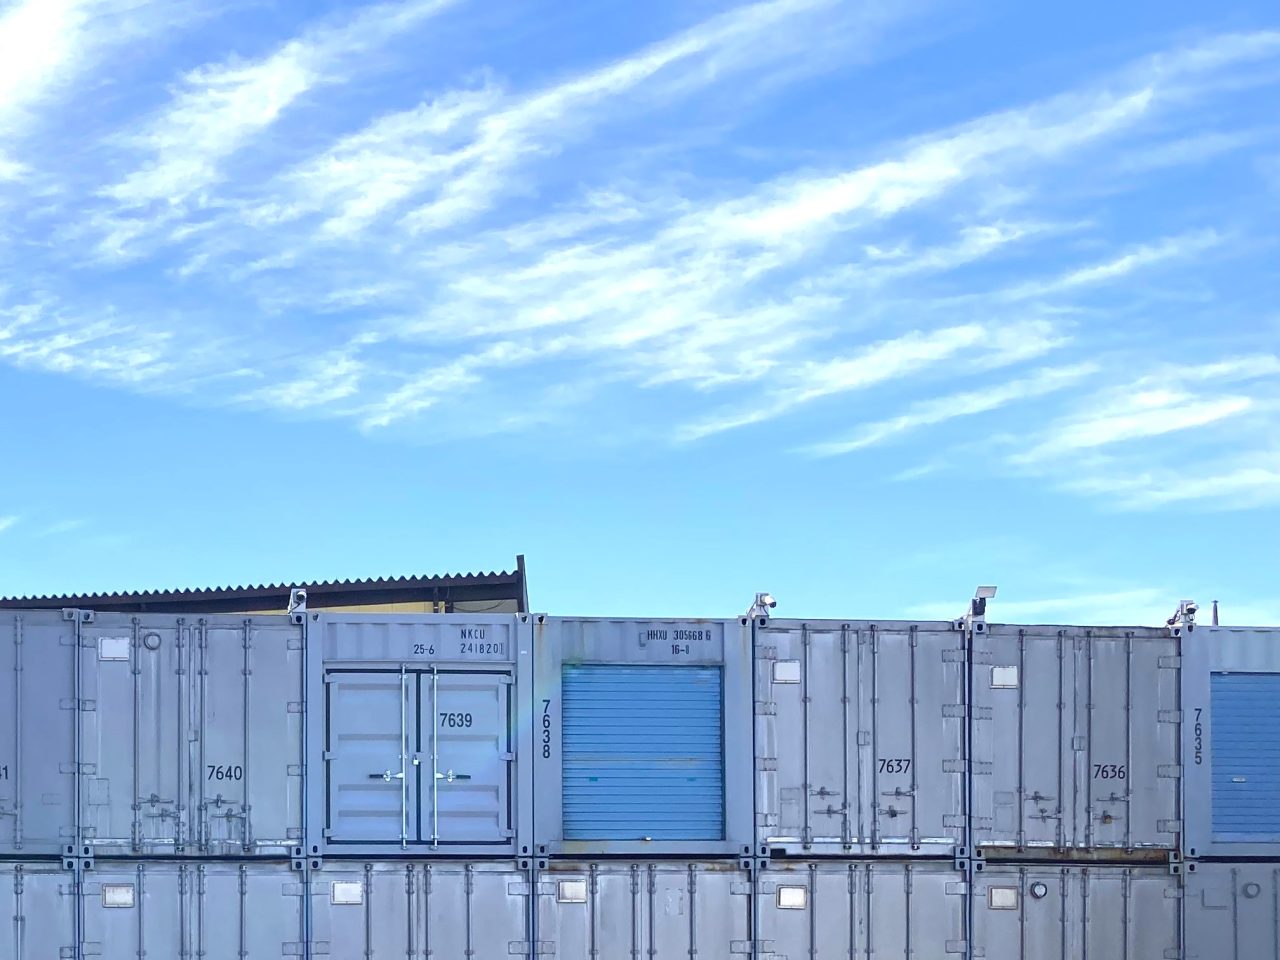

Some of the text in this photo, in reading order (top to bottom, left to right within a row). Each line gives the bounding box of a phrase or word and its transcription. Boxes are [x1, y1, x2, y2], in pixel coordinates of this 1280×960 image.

[461, 628, 485, 640] NKCU
[413, 644, 435, 655] 25-6
[439, 712, 473, 729] 7639
[541, 699, 552, 760] 7638
[1193, 708, 1203, 766] 7635
[207, 765, 243, 782] 7640
[878, 759, 911, 775] 7637
[1093, 765, 1126, 780] 7636
